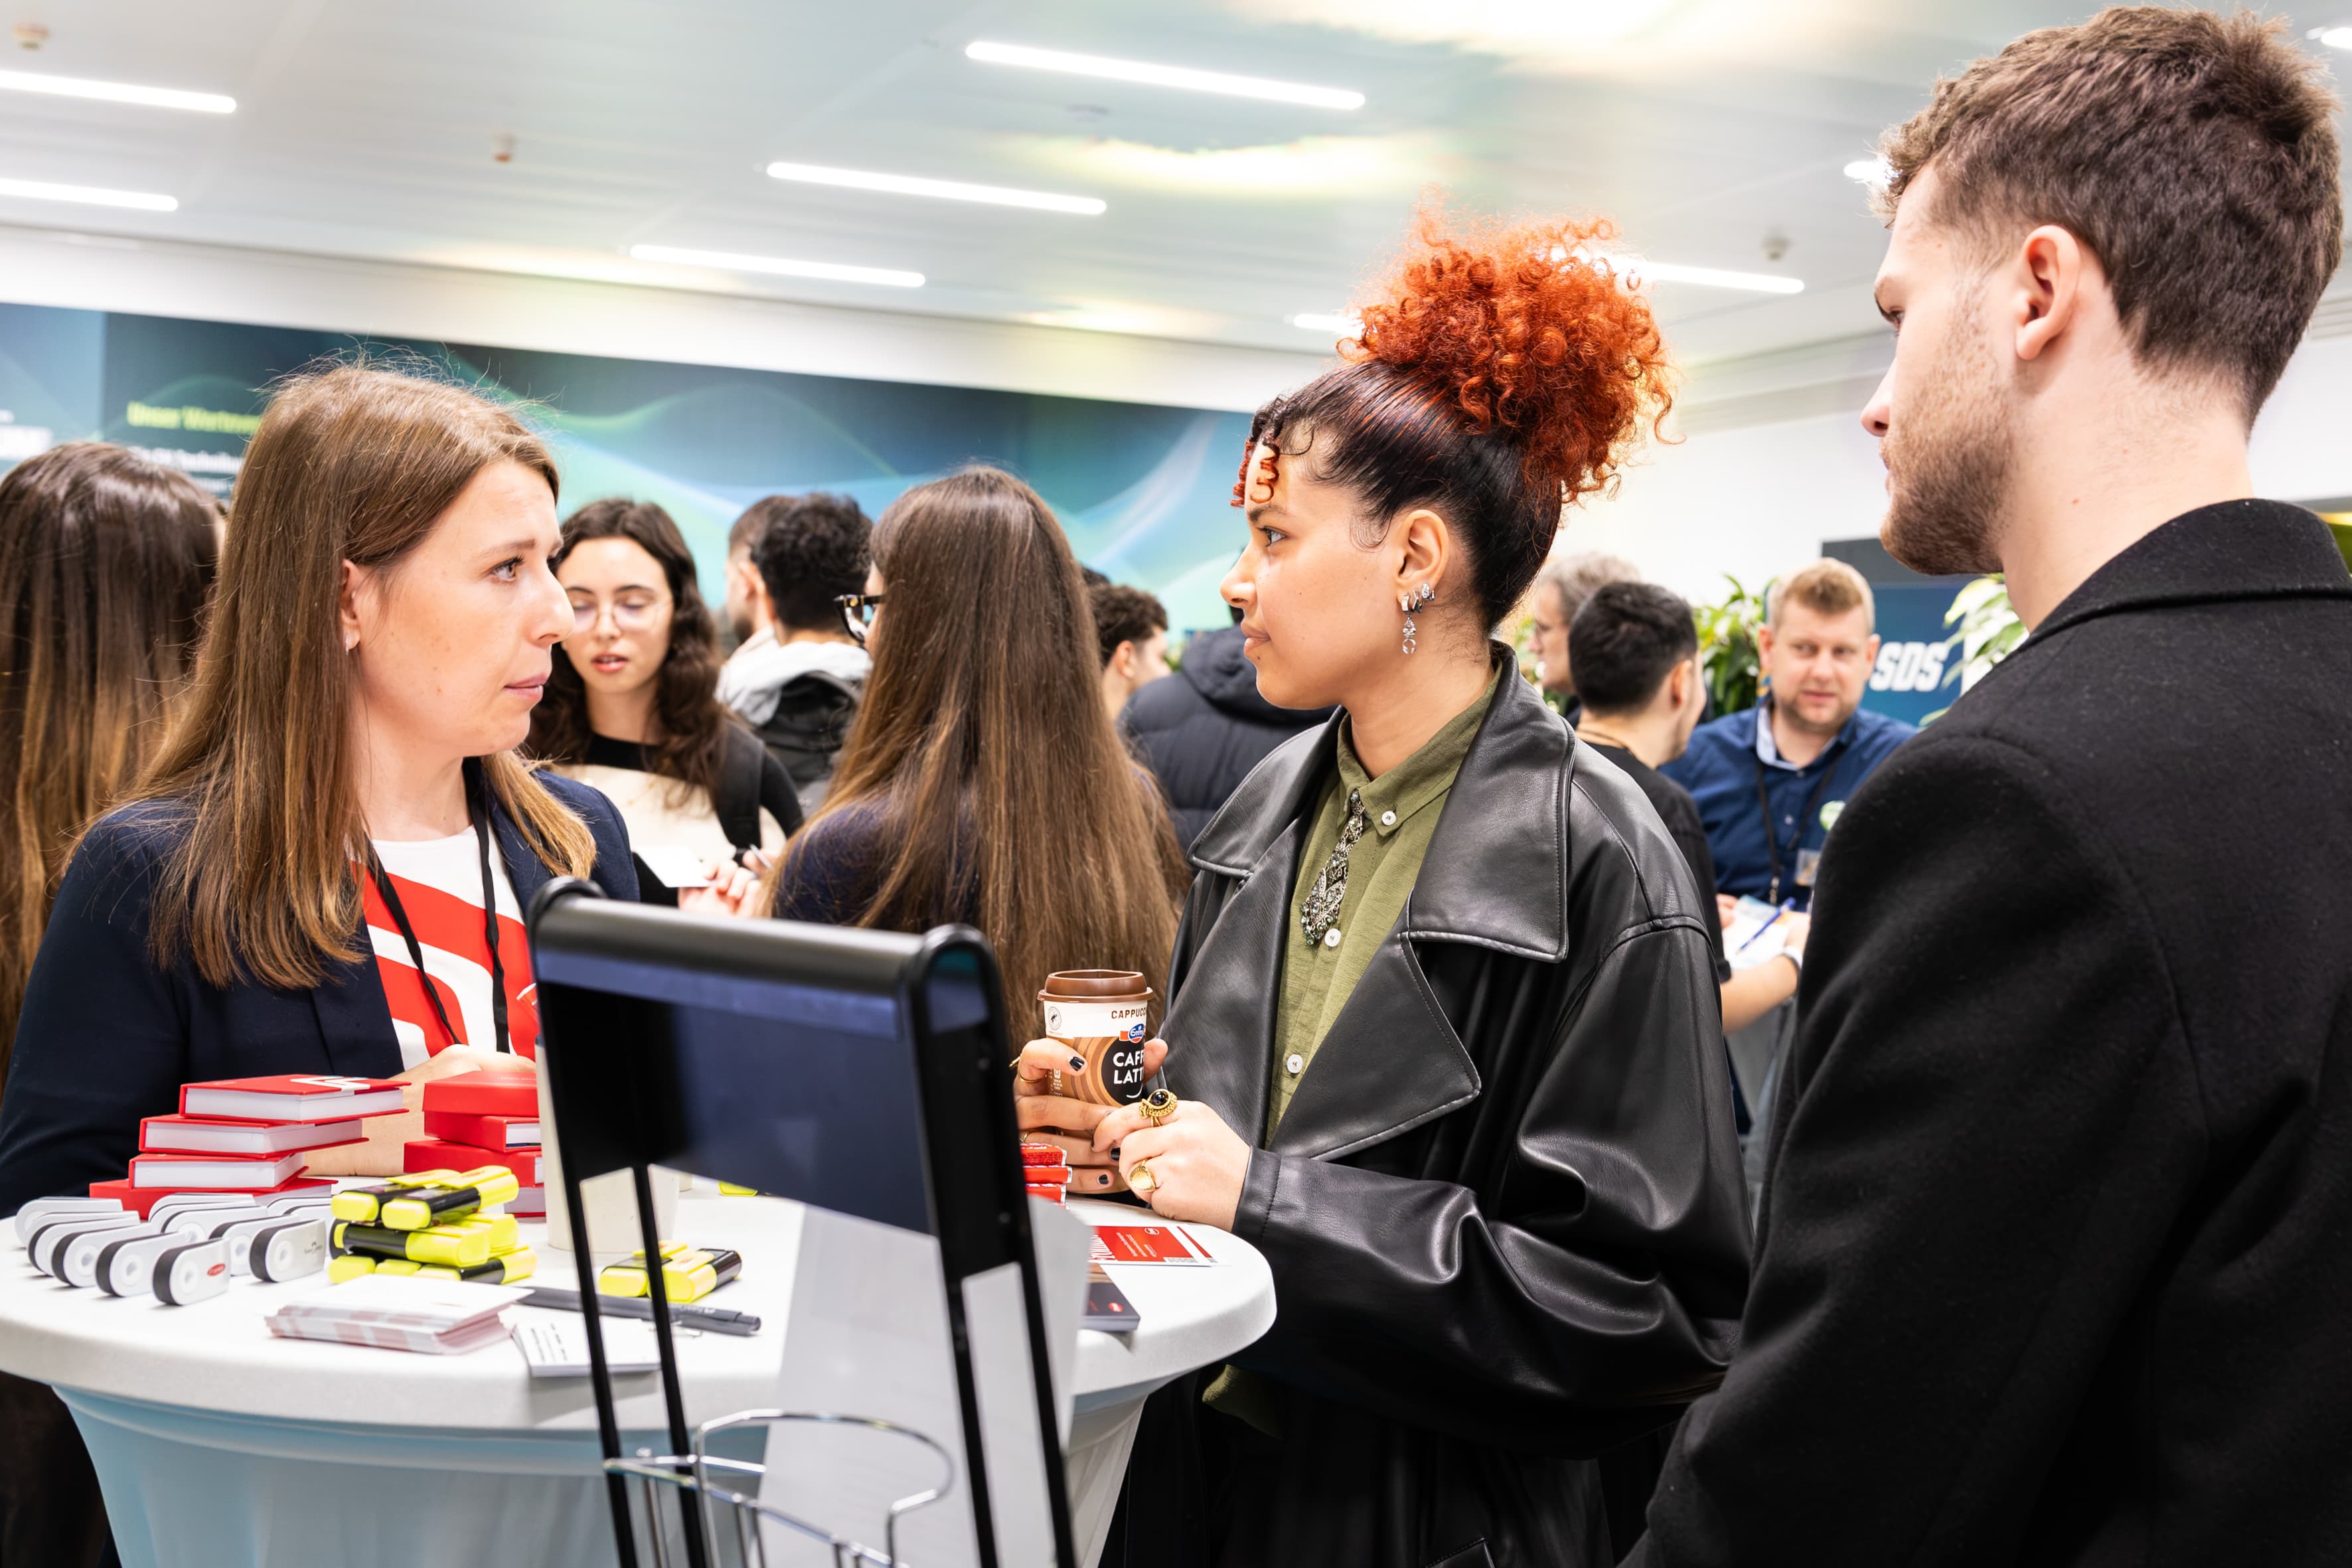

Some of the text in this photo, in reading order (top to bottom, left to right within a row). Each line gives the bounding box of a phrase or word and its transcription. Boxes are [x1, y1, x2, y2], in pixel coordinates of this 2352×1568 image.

[1869, 641, 1949, 692] SDS
[1113, 1050, 1145, 1067] CAFF
[1113, 1067, 1144, 1084] LATT
